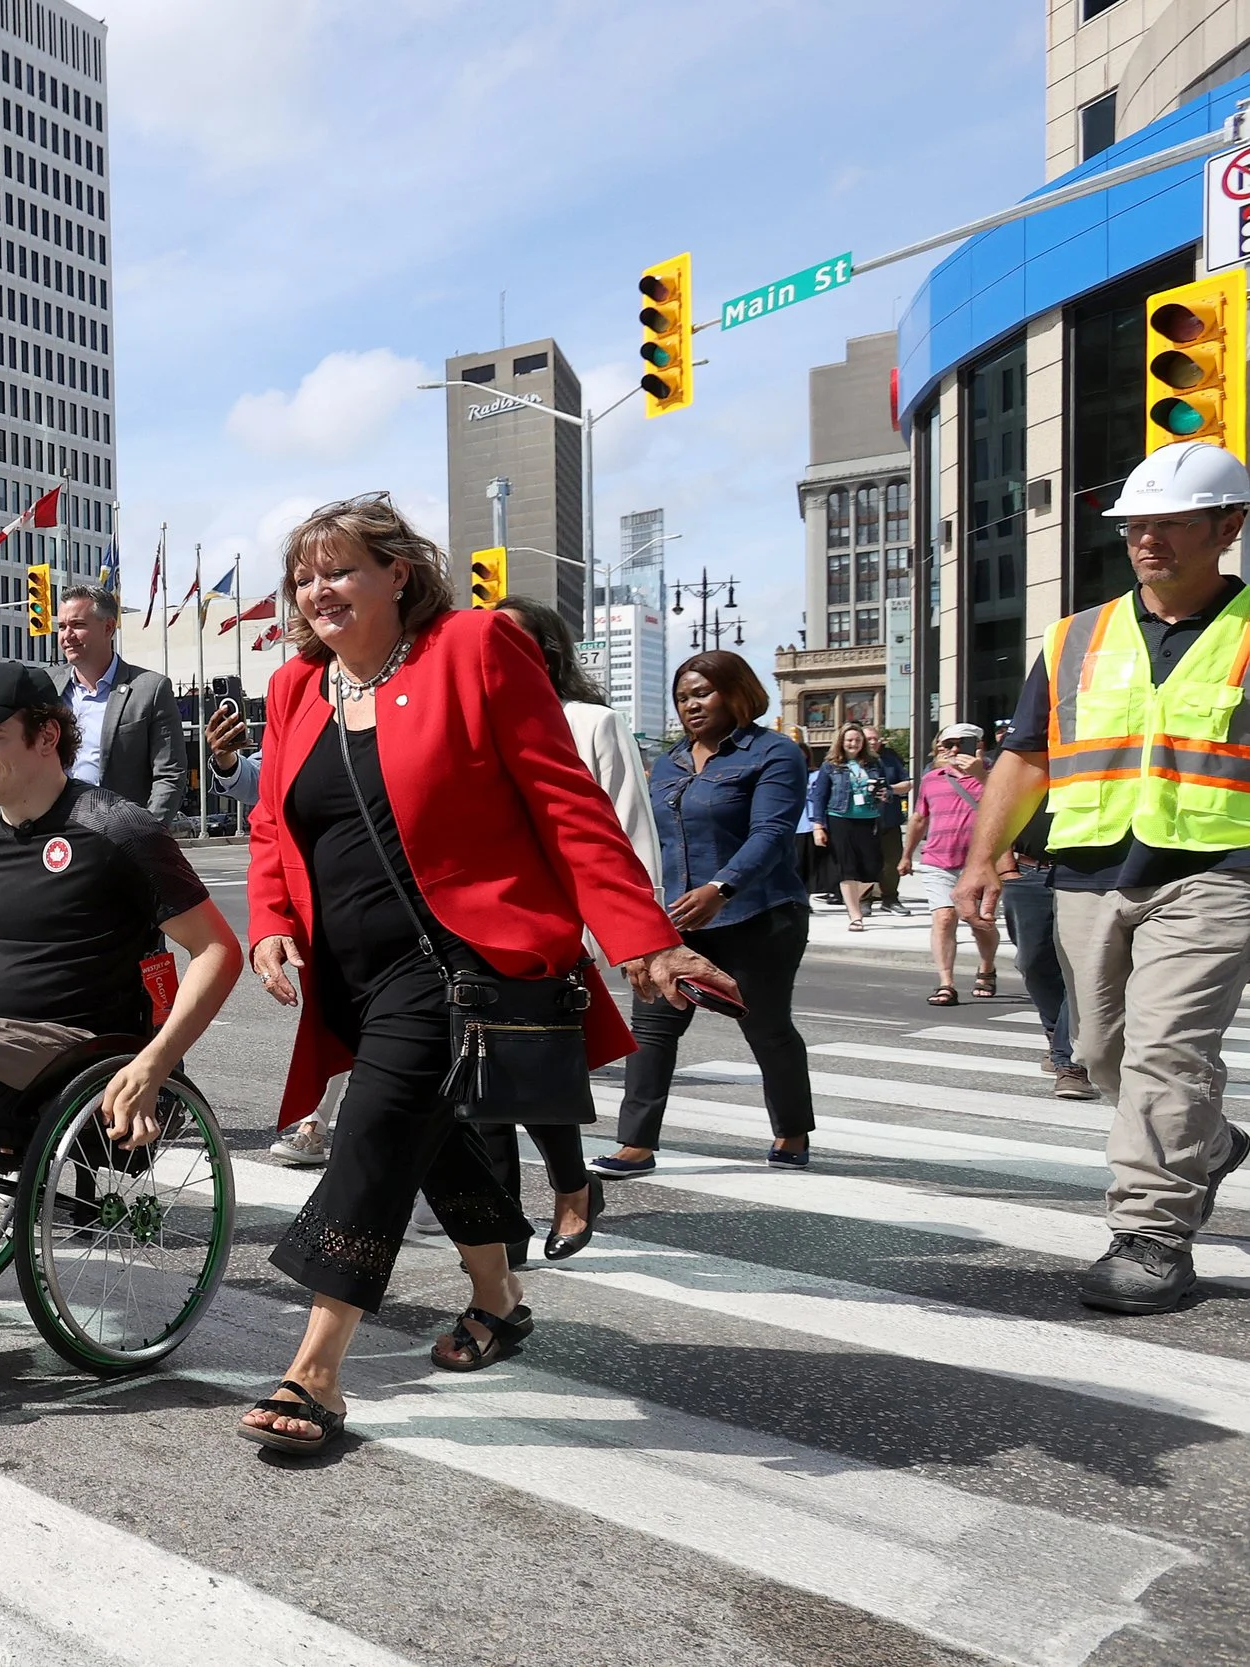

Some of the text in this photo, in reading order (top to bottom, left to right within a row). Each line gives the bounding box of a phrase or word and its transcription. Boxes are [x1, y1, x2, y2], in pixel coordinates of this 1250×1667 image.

[725, 259, 848, 327] Main St
[579, 652, 600, 665] 57
